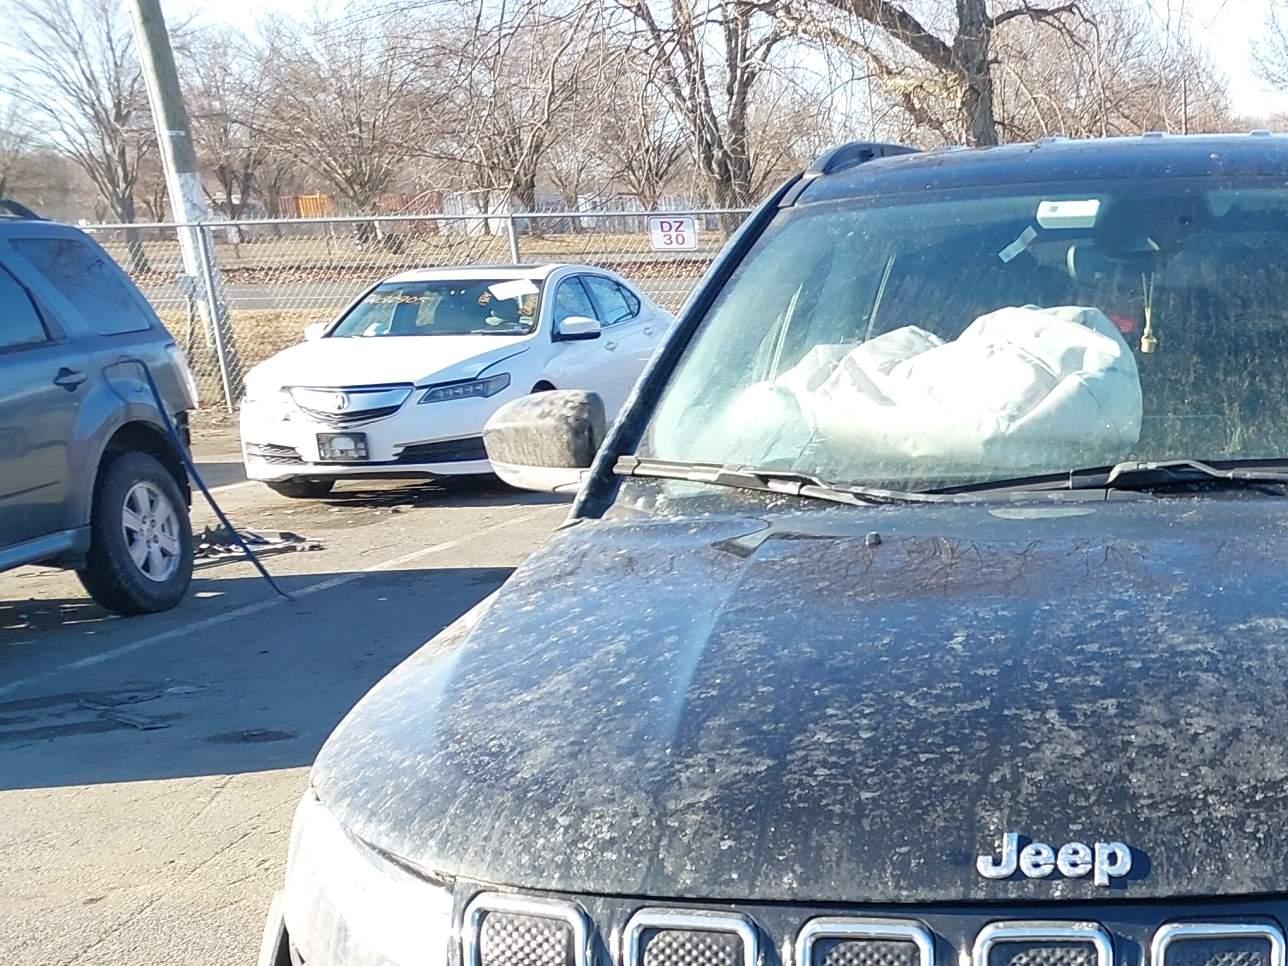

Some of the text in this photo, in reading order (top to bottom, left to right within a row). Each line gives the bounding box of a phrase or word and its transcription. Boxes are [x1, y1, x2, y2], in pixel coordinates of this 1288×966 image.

[659, 220, 685, 233] DZ
[662, 233, 685, 246] 30
[976, 832, 1133, 887] Jeep
